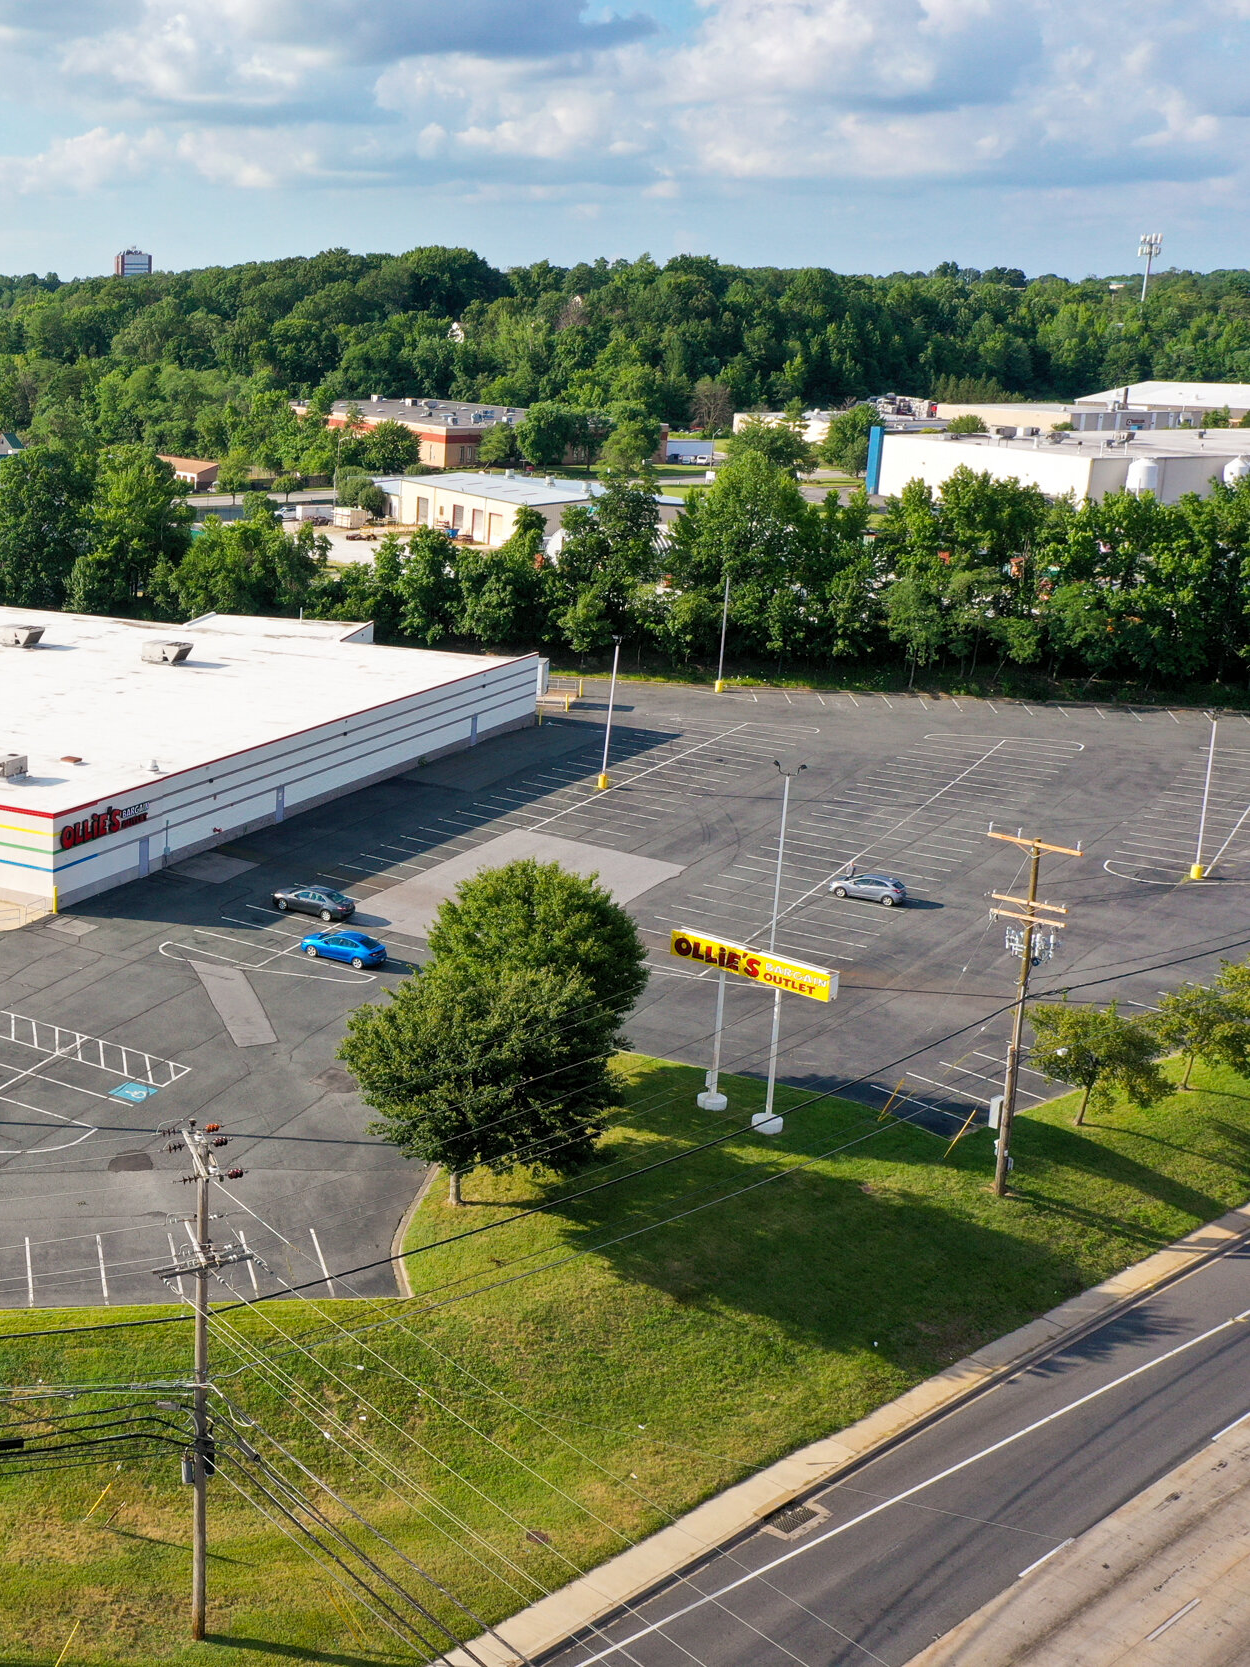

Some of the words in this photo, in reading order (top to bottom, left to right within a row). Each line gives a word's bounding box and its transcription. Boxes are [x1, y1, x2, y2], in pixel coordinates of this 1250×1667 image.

[121, 801, 150, 819] BARGAIN
[763, 972, 816, 995] OUTLET
[765, 962, 828, 988] BARGAIN
